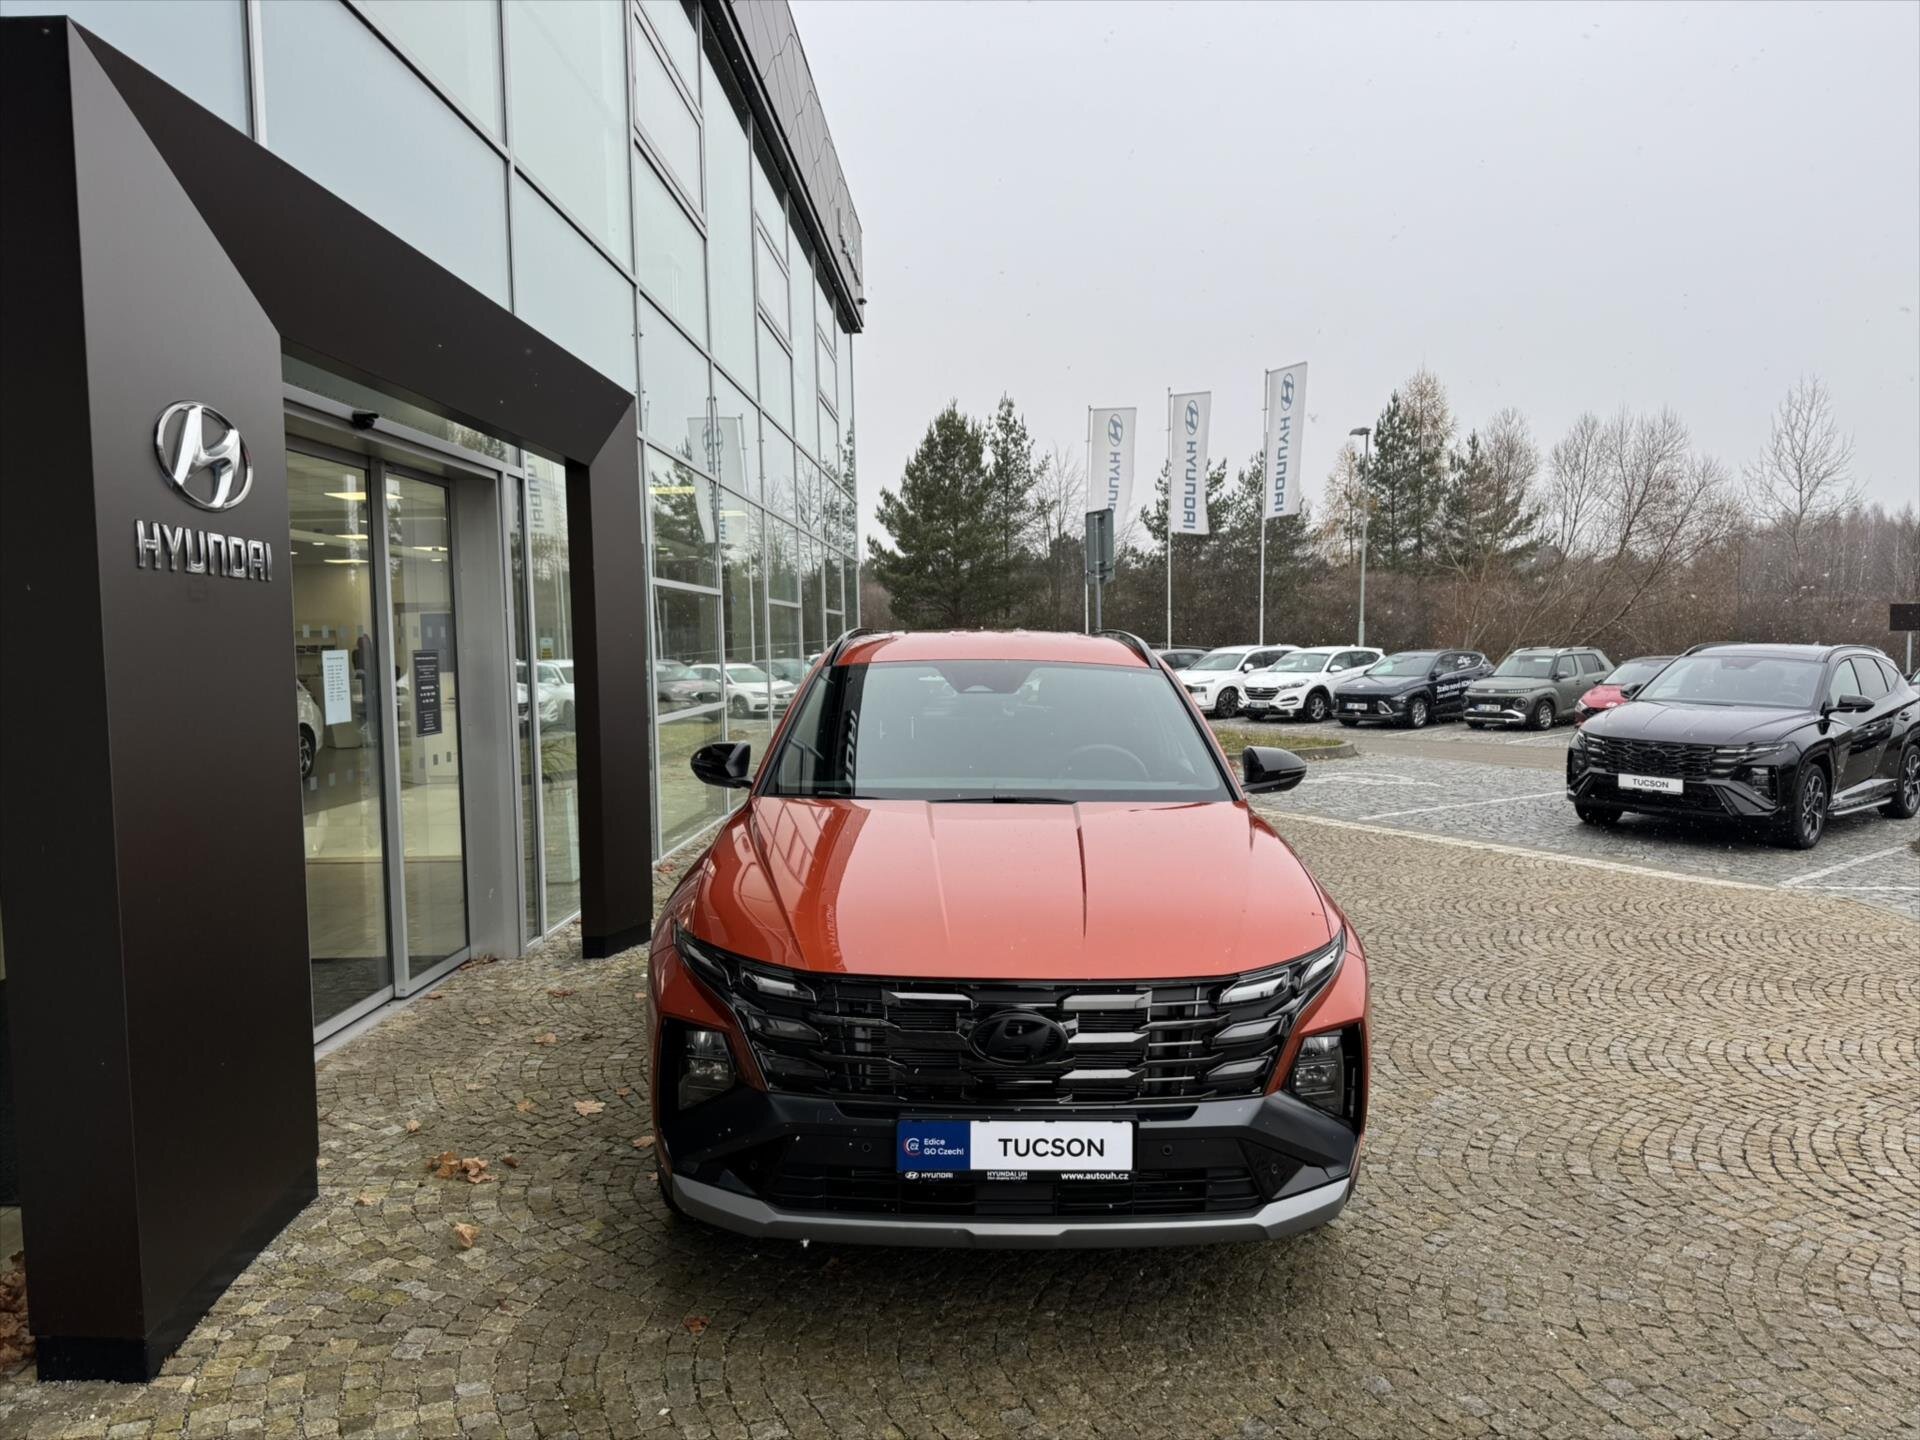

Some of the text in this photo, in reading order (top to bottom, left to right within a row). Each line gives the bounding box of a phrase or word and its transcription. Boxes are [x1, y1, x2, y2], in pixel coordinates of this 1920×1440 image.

[1275, 416, 1290, 512] HYUNDAI
[1183, 441, 1197, 529] HYUNDAI
[135, 520, 272, 581] HYUNDAI
[1632, 778, 1669, 788] TUCSON
[923, 1138, 946, 1146] Edice
[998, 1138, 1104, 1157] TUCSON
[1061, 1172, 1129, 1180] www.autouh.cz
